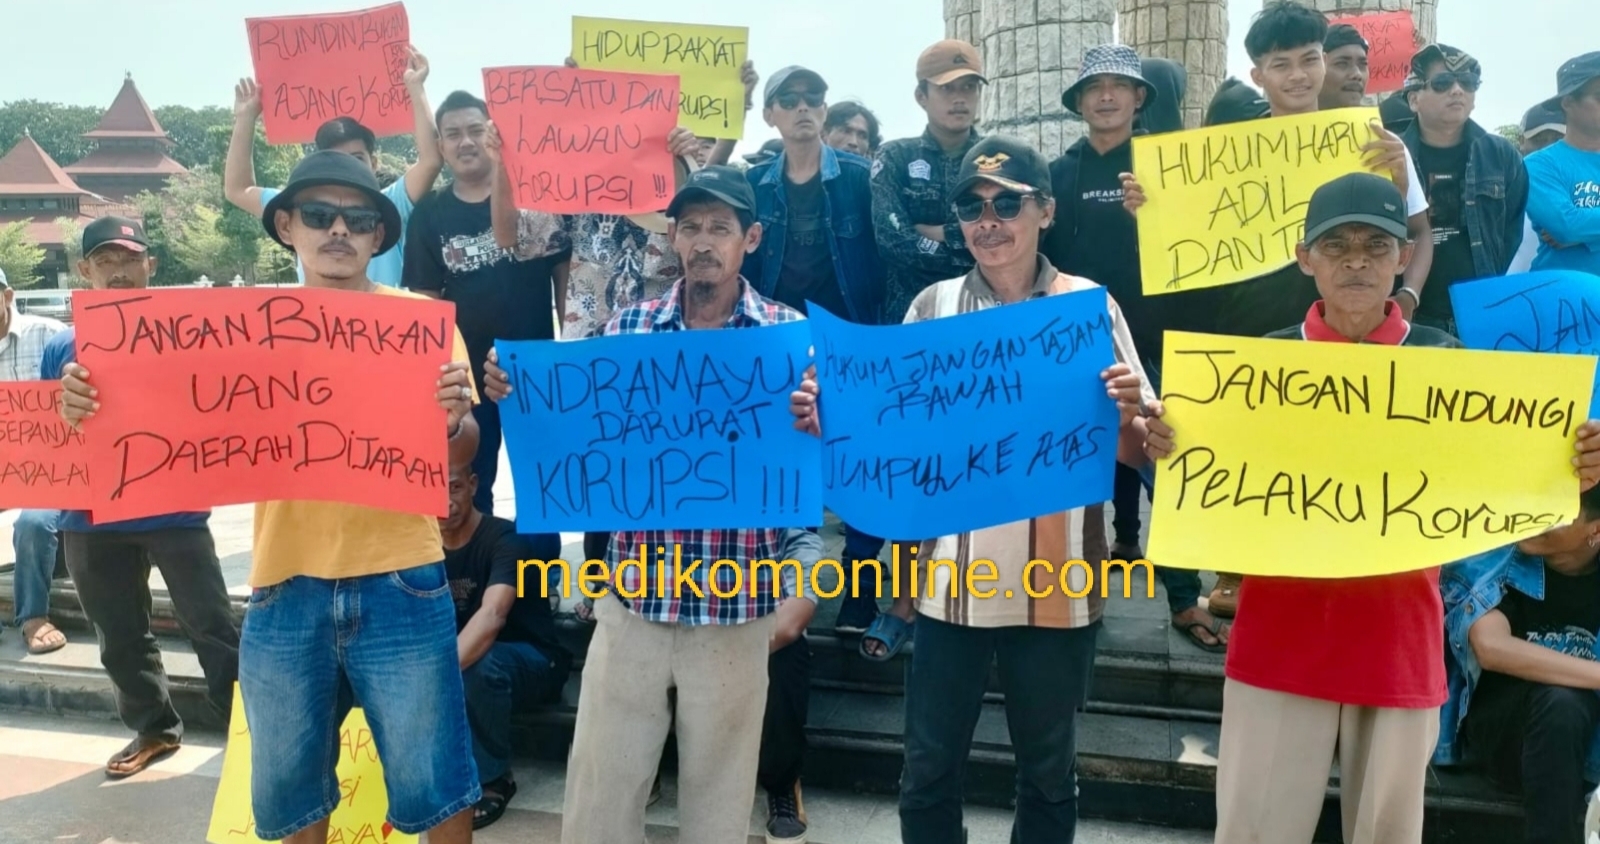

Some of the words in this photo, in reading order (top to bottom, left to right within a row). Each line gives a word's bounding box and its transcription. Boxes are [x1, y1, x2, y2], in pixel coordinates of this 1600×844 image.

[250, 20, 357, 61] RUMDIN
[583, 30, 660, 63] HIDUP
[663, 32, 745, 68] RAKYAT
[274, 83, 357, 120] AJANG
[486, 69, 617, 111] BERSATU
[621, 81, 675, 114] DAN
[517, 114, 642, 155] LAWAN
[1157, 129, 1290, 190] HUKUM
[1166, 232, 1266, 289] DAN
[81, 296, 250, 354] JANGAN
[823, 334, 896, 393] HUKUM
[902, 336, 1027, 384] JANGAN
[1029, 312, 1113, 365] TAJAM
[191, 370, 333, 413] UANG
[878, 370, 1023, 426] BAWAH
[1162, 350, 1370, 414] JANGAN
[1387, 361, 1575, 438] LINDUNGI
[0, 419, 85, 449] SEPANJA
[587, 401, 773, 447] DARURAT
[111, 431, 293, 500] DAERAH
[967, 432, 1019, 483] KE
[1026, 422, 1107, 477] ATAS
